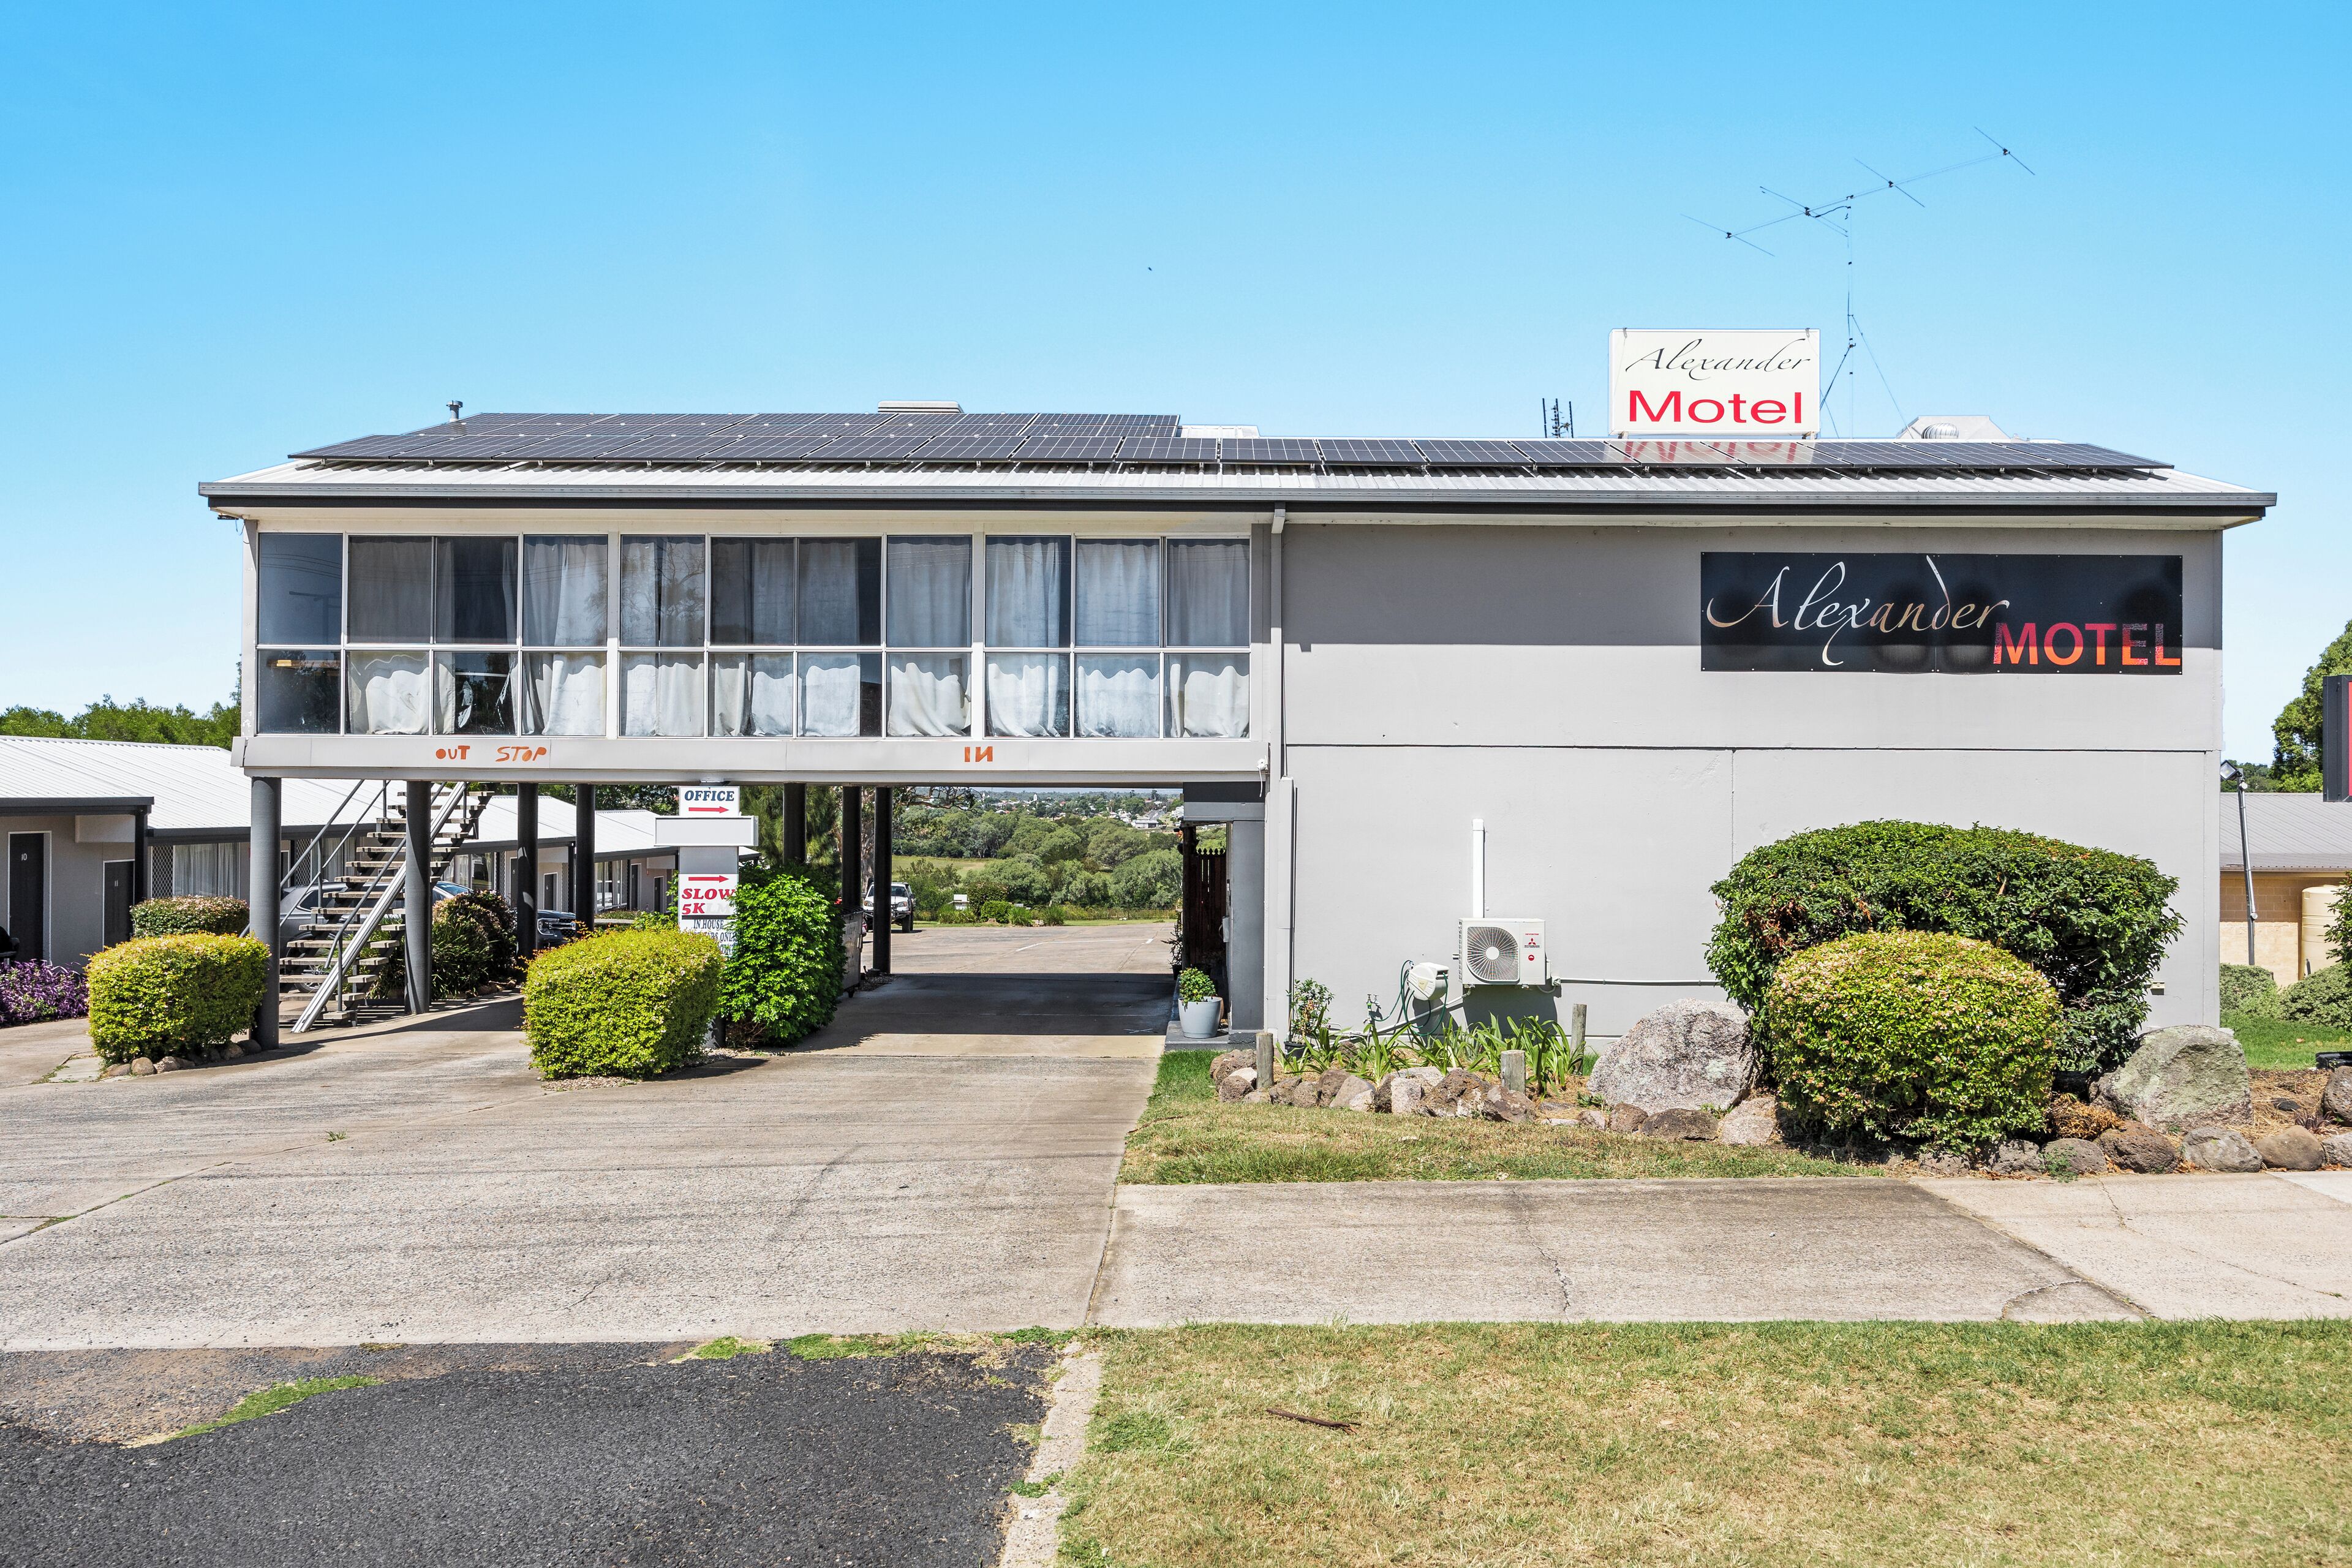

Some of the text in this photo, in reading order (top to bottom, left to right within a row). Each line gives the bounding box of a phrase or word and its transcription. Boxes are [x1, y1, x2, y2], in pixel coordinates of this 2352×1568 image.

[1625, 338, 1811, 380] Alexander
[1629, 390, 1802, 424] Motel
[1706, 554, 2010, 666] Alexander
[1993, 622, 2181, 666] MOTEL
[435, 745, 547, 762] OUT STOP
[684, 790, 735, 802] OFFICE
[21, 853, 28, 861] 10
[681, 888, 736, 900] SLOW
[693, 919, 724, 930] IN HOUSE
